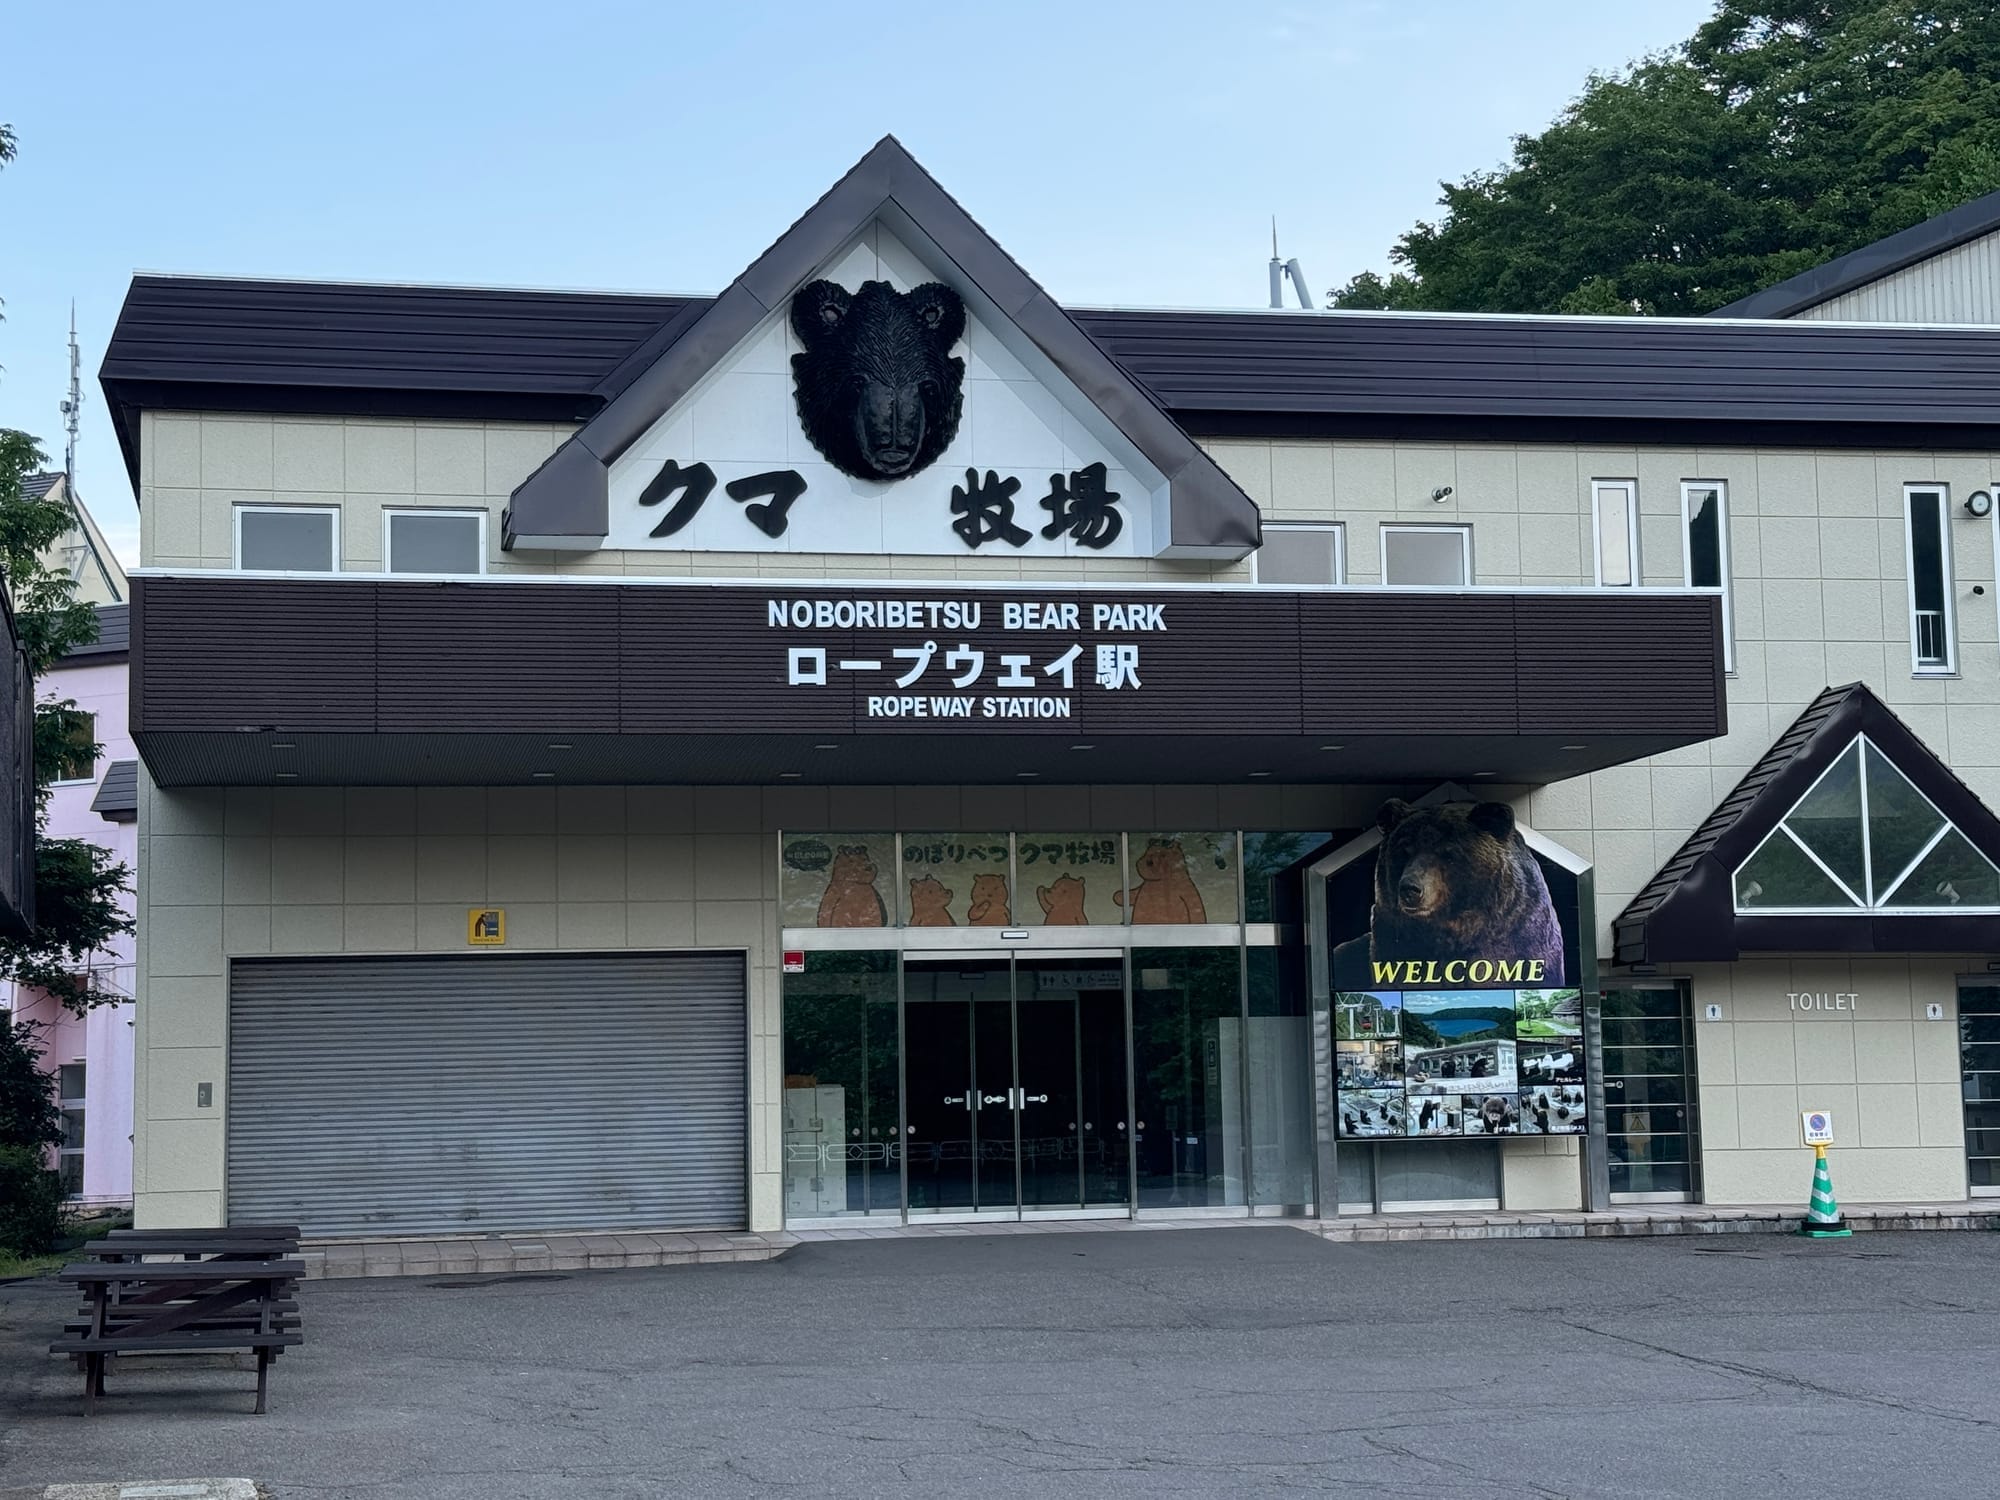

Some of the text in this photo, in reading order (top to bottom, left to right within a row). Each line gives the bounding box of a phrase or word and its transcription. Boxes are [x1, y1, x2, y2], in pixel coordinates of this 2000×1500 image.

[638, 459, 1124, 550] クマ 牧場
[768, 600, 1168, 631] NOBORIBETSU BEAR PARK
[788, 640, 1142, 690] ロープウェイ駅
[982, 697, 1071, 718] STATION
[902, 840, 1116, 865] のぼりべつ クマ牧場
[1371, 959, 1546, 984] WELCOME
[1786, 992, 1860, 1011] TOILET
